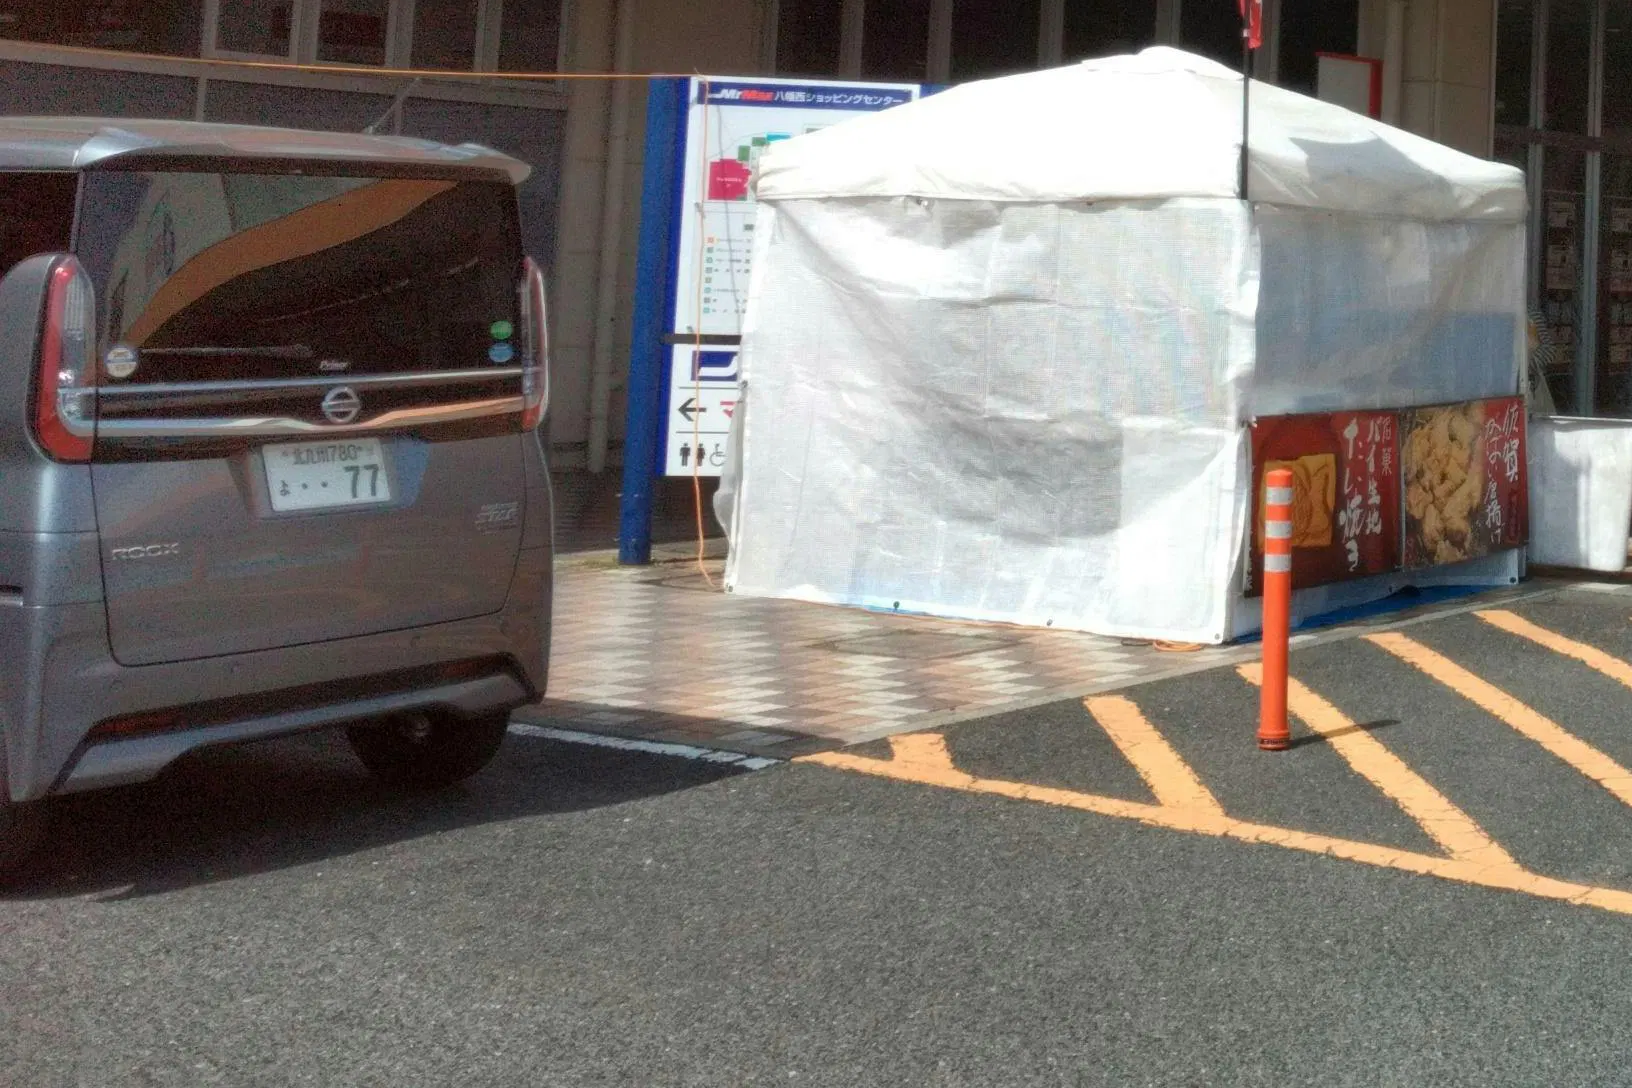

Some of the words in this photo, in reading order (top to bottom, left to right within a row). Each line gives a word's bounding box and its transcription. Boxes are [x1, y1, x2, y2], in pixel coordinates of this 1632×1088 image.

[774, 91, 904, 106] 八幡西ショッピングセンター
[343, 463, 379, 499] 77
